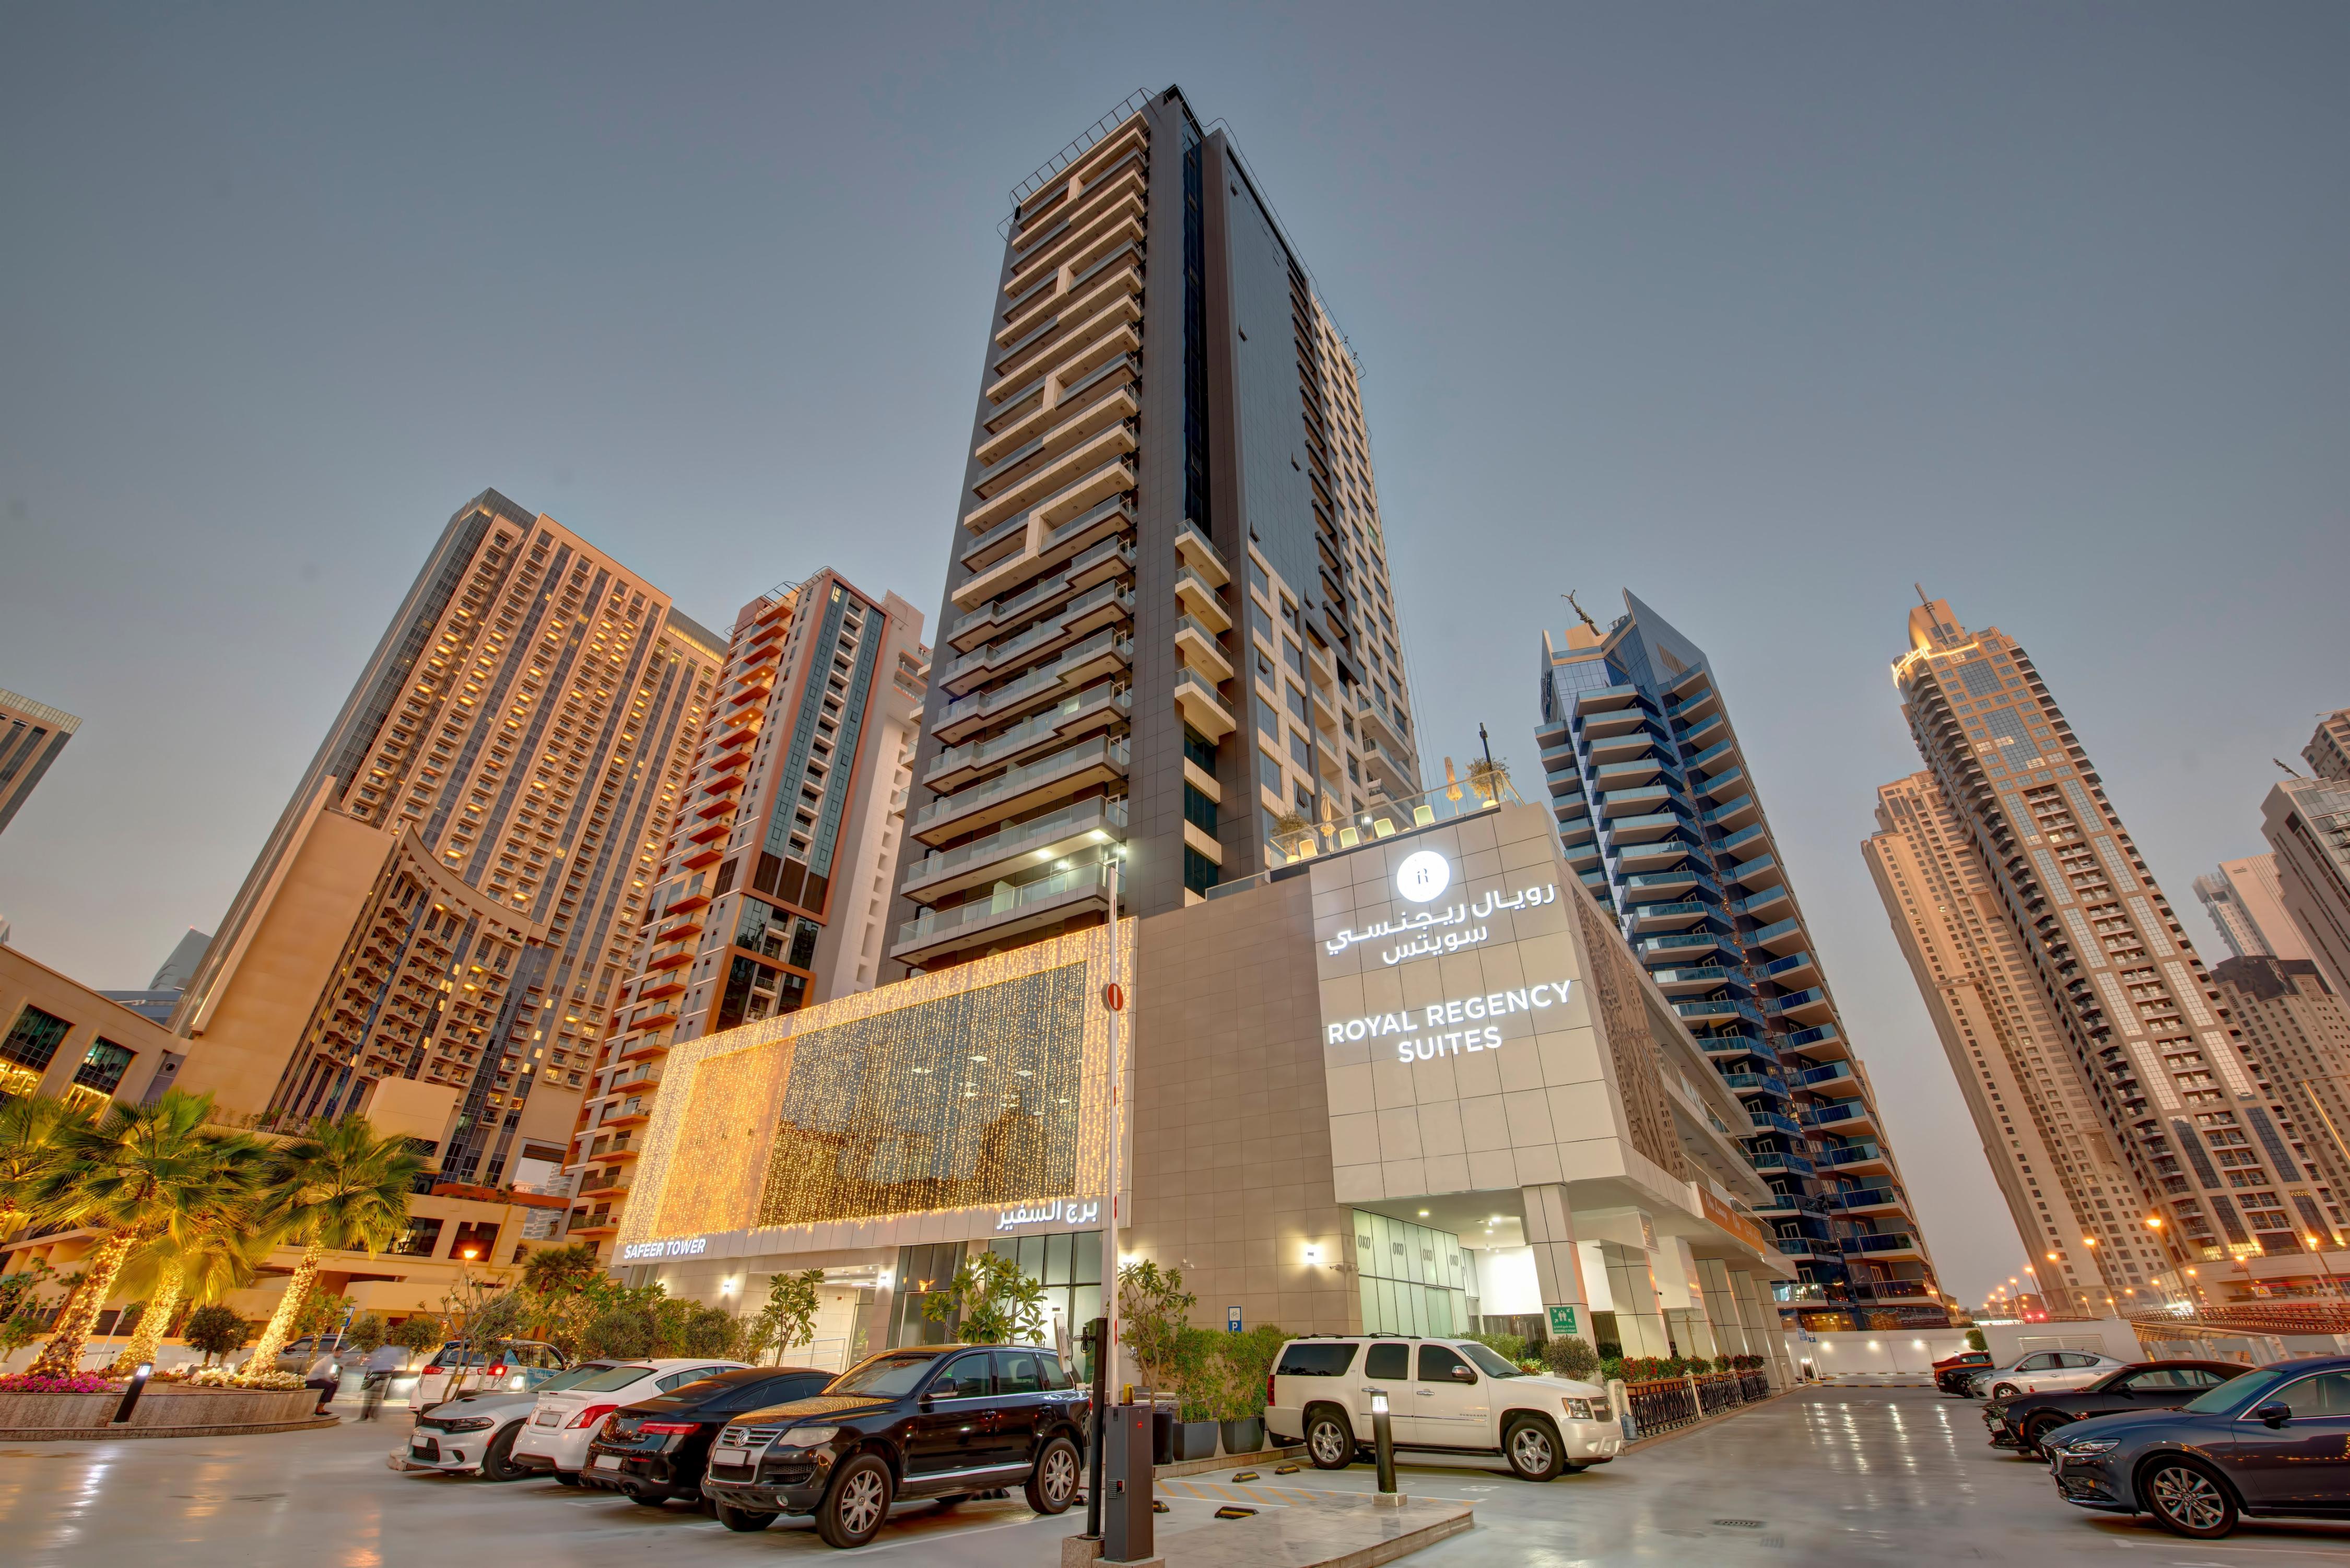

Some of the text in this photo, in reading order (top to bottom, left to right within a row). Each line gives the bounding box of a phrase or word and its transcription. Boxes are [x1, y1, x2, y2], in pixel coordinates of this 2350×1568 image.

[1325, 882, 1557, 956] رويال ريجنسي
[1382, 926, 1488, 965] سويتس
[1327, 979, 1572, 1045] ROYAL REGENCY
[1399, 1027, 1502, 1063] SUITES
[996, 1199, 1098, 1231] برج السفير
[624, 1238, 706, 1259] SAFEER TOWER
[1358, 1234, 1370, 1250] OKO
[1393, 1242, 1404, 1256] OKO
[1423, 1248, 1433, 1262] OKO
[1450, 1254, 1459, 1267] OKO
[1232, 1322, 1238, 1331] P
